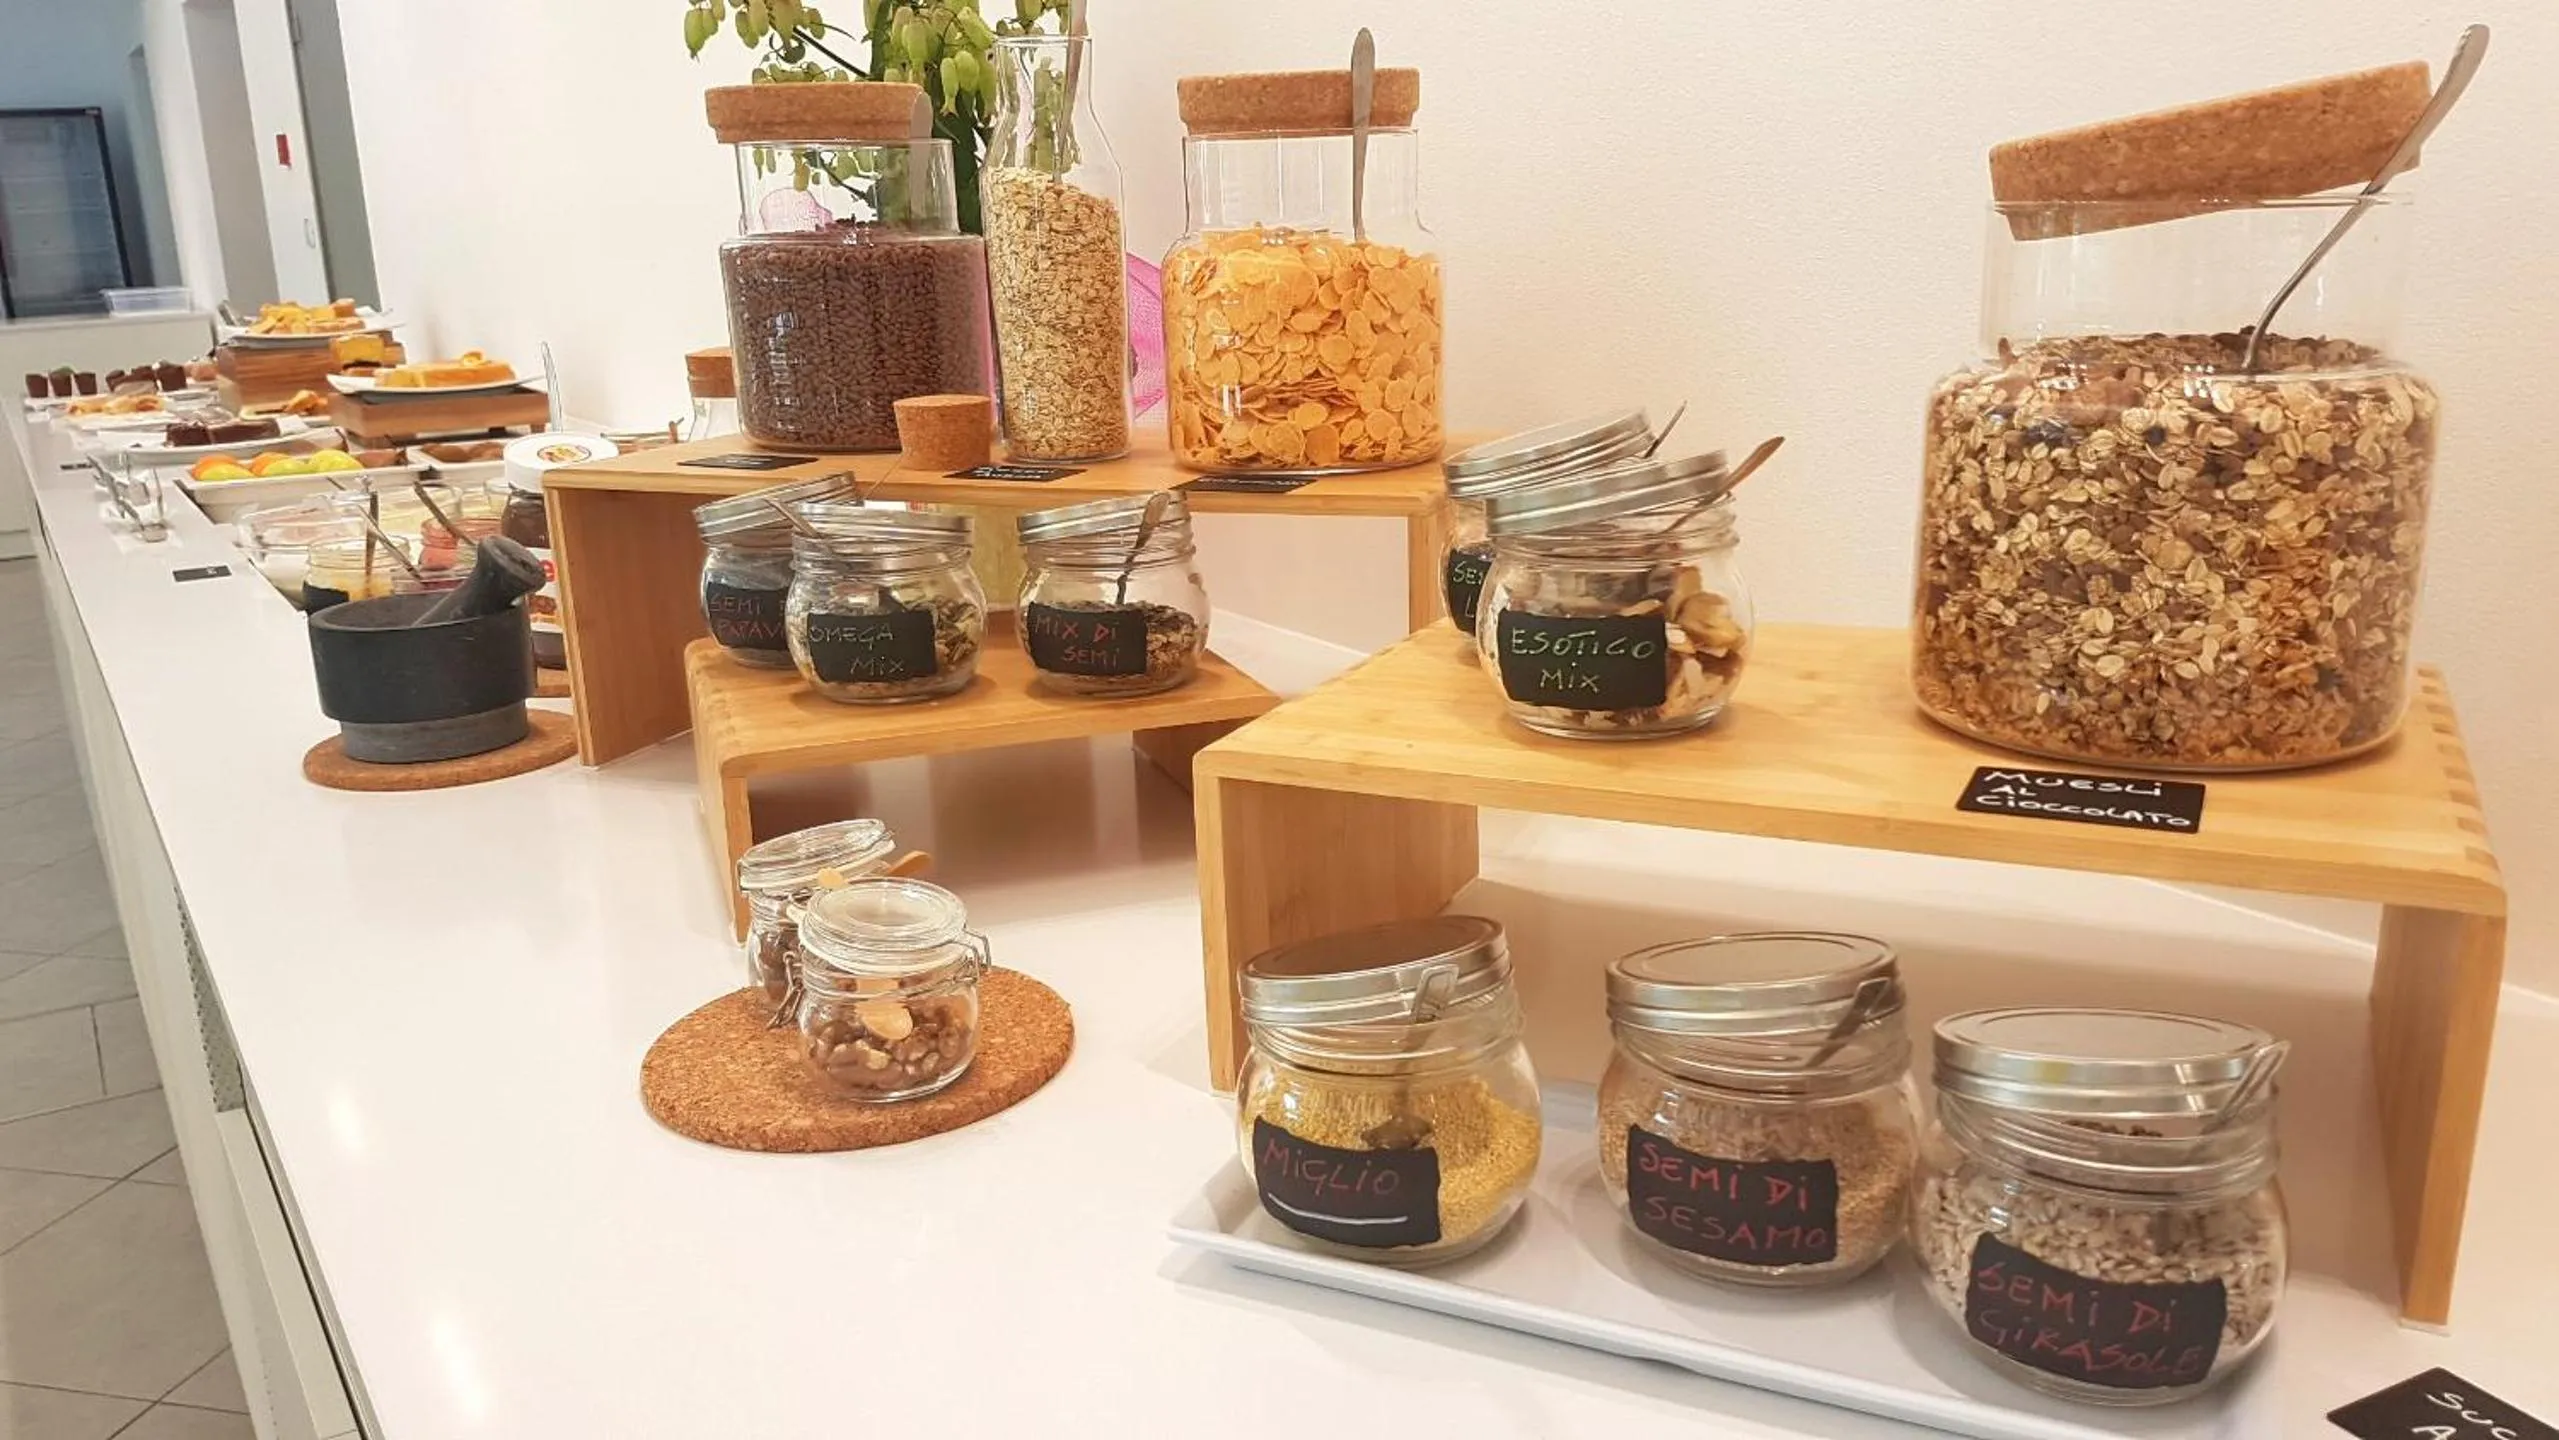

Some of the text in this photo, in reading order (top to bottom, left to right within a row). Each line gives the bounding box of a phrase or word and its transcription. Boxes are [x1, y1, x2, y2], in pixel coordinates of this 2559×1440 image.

[809, 624, 893, 651] OMEGA
[1034, 613, 1119, 642] MIX DI
[1510, 627, 1656, 660] ESOTICO
[1060, 645, 1119, 671] SEMI
[1539, 661, 1600, 693] MIX
[1983, 771, 2163, 797] MUESLI
[1990, 784, 2037, 797] AL
[1975, 794, 2191, 827] CIOCCOLATO
[1263, 1137, 1399, 1196] MIGLIO
[1638, 1142, 1808, 1213] SEMI DI
[1645, 1195, 1827, 1250] SESAMO
[1977, 1261, 2177, 1334] SEMI DI
[1979, 1308, 2206, 1375] GIRASOLE
